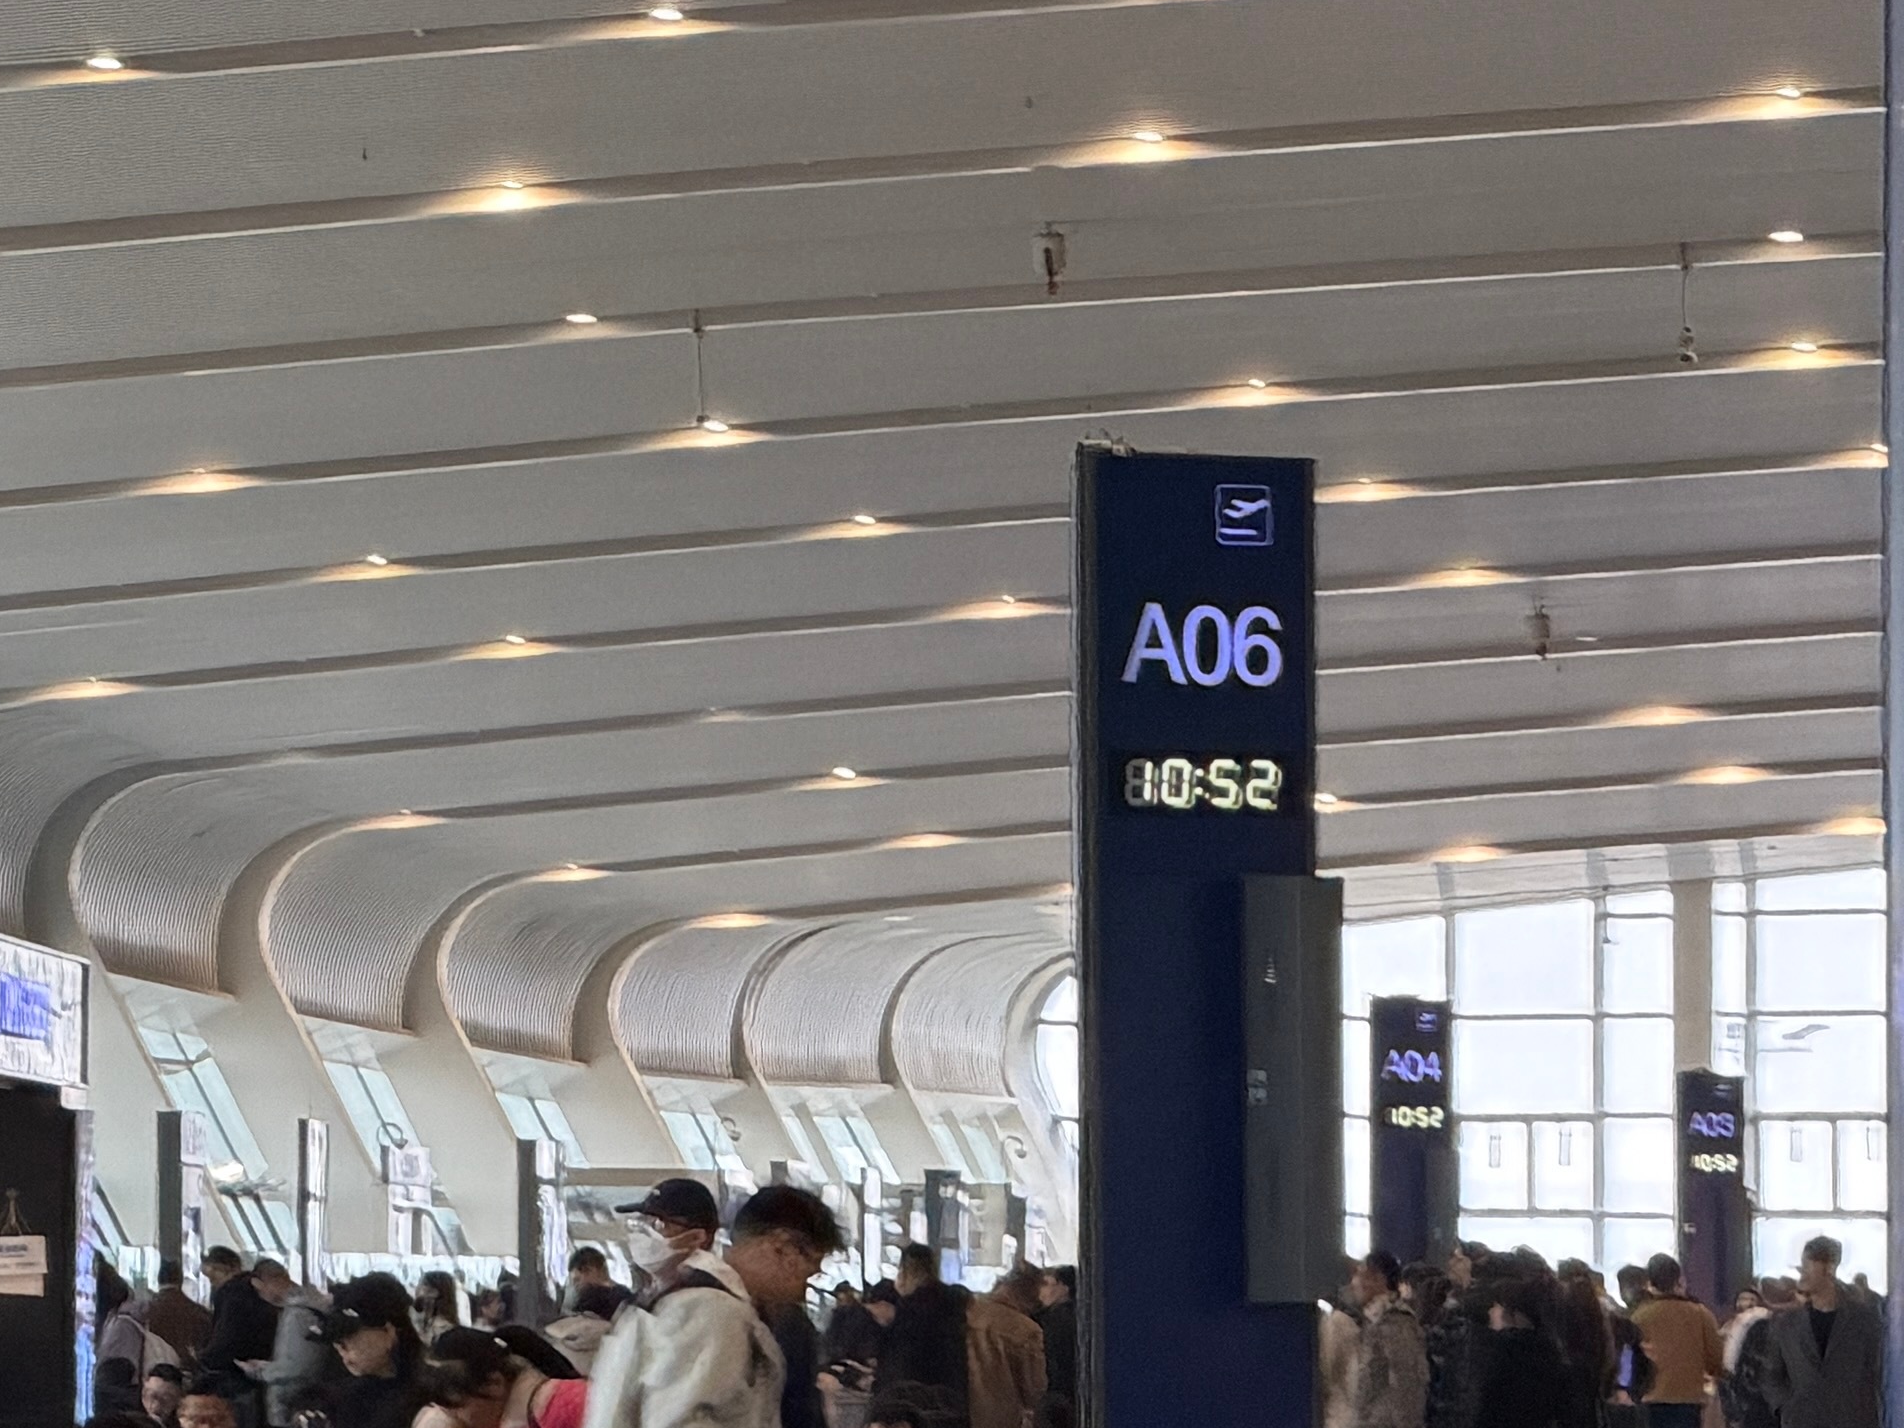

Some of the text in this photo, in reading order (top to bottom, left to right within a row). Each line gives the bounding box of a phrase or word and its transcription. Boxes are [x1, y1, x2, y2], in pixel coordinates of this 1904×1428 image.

[1120, 602, 1284, 688] A06
[1140, 757, 1283, 810] 10:52
[1380, 1049, 1443, 1083] A04
[1389, 1105, 1445, 1128] 10:52
